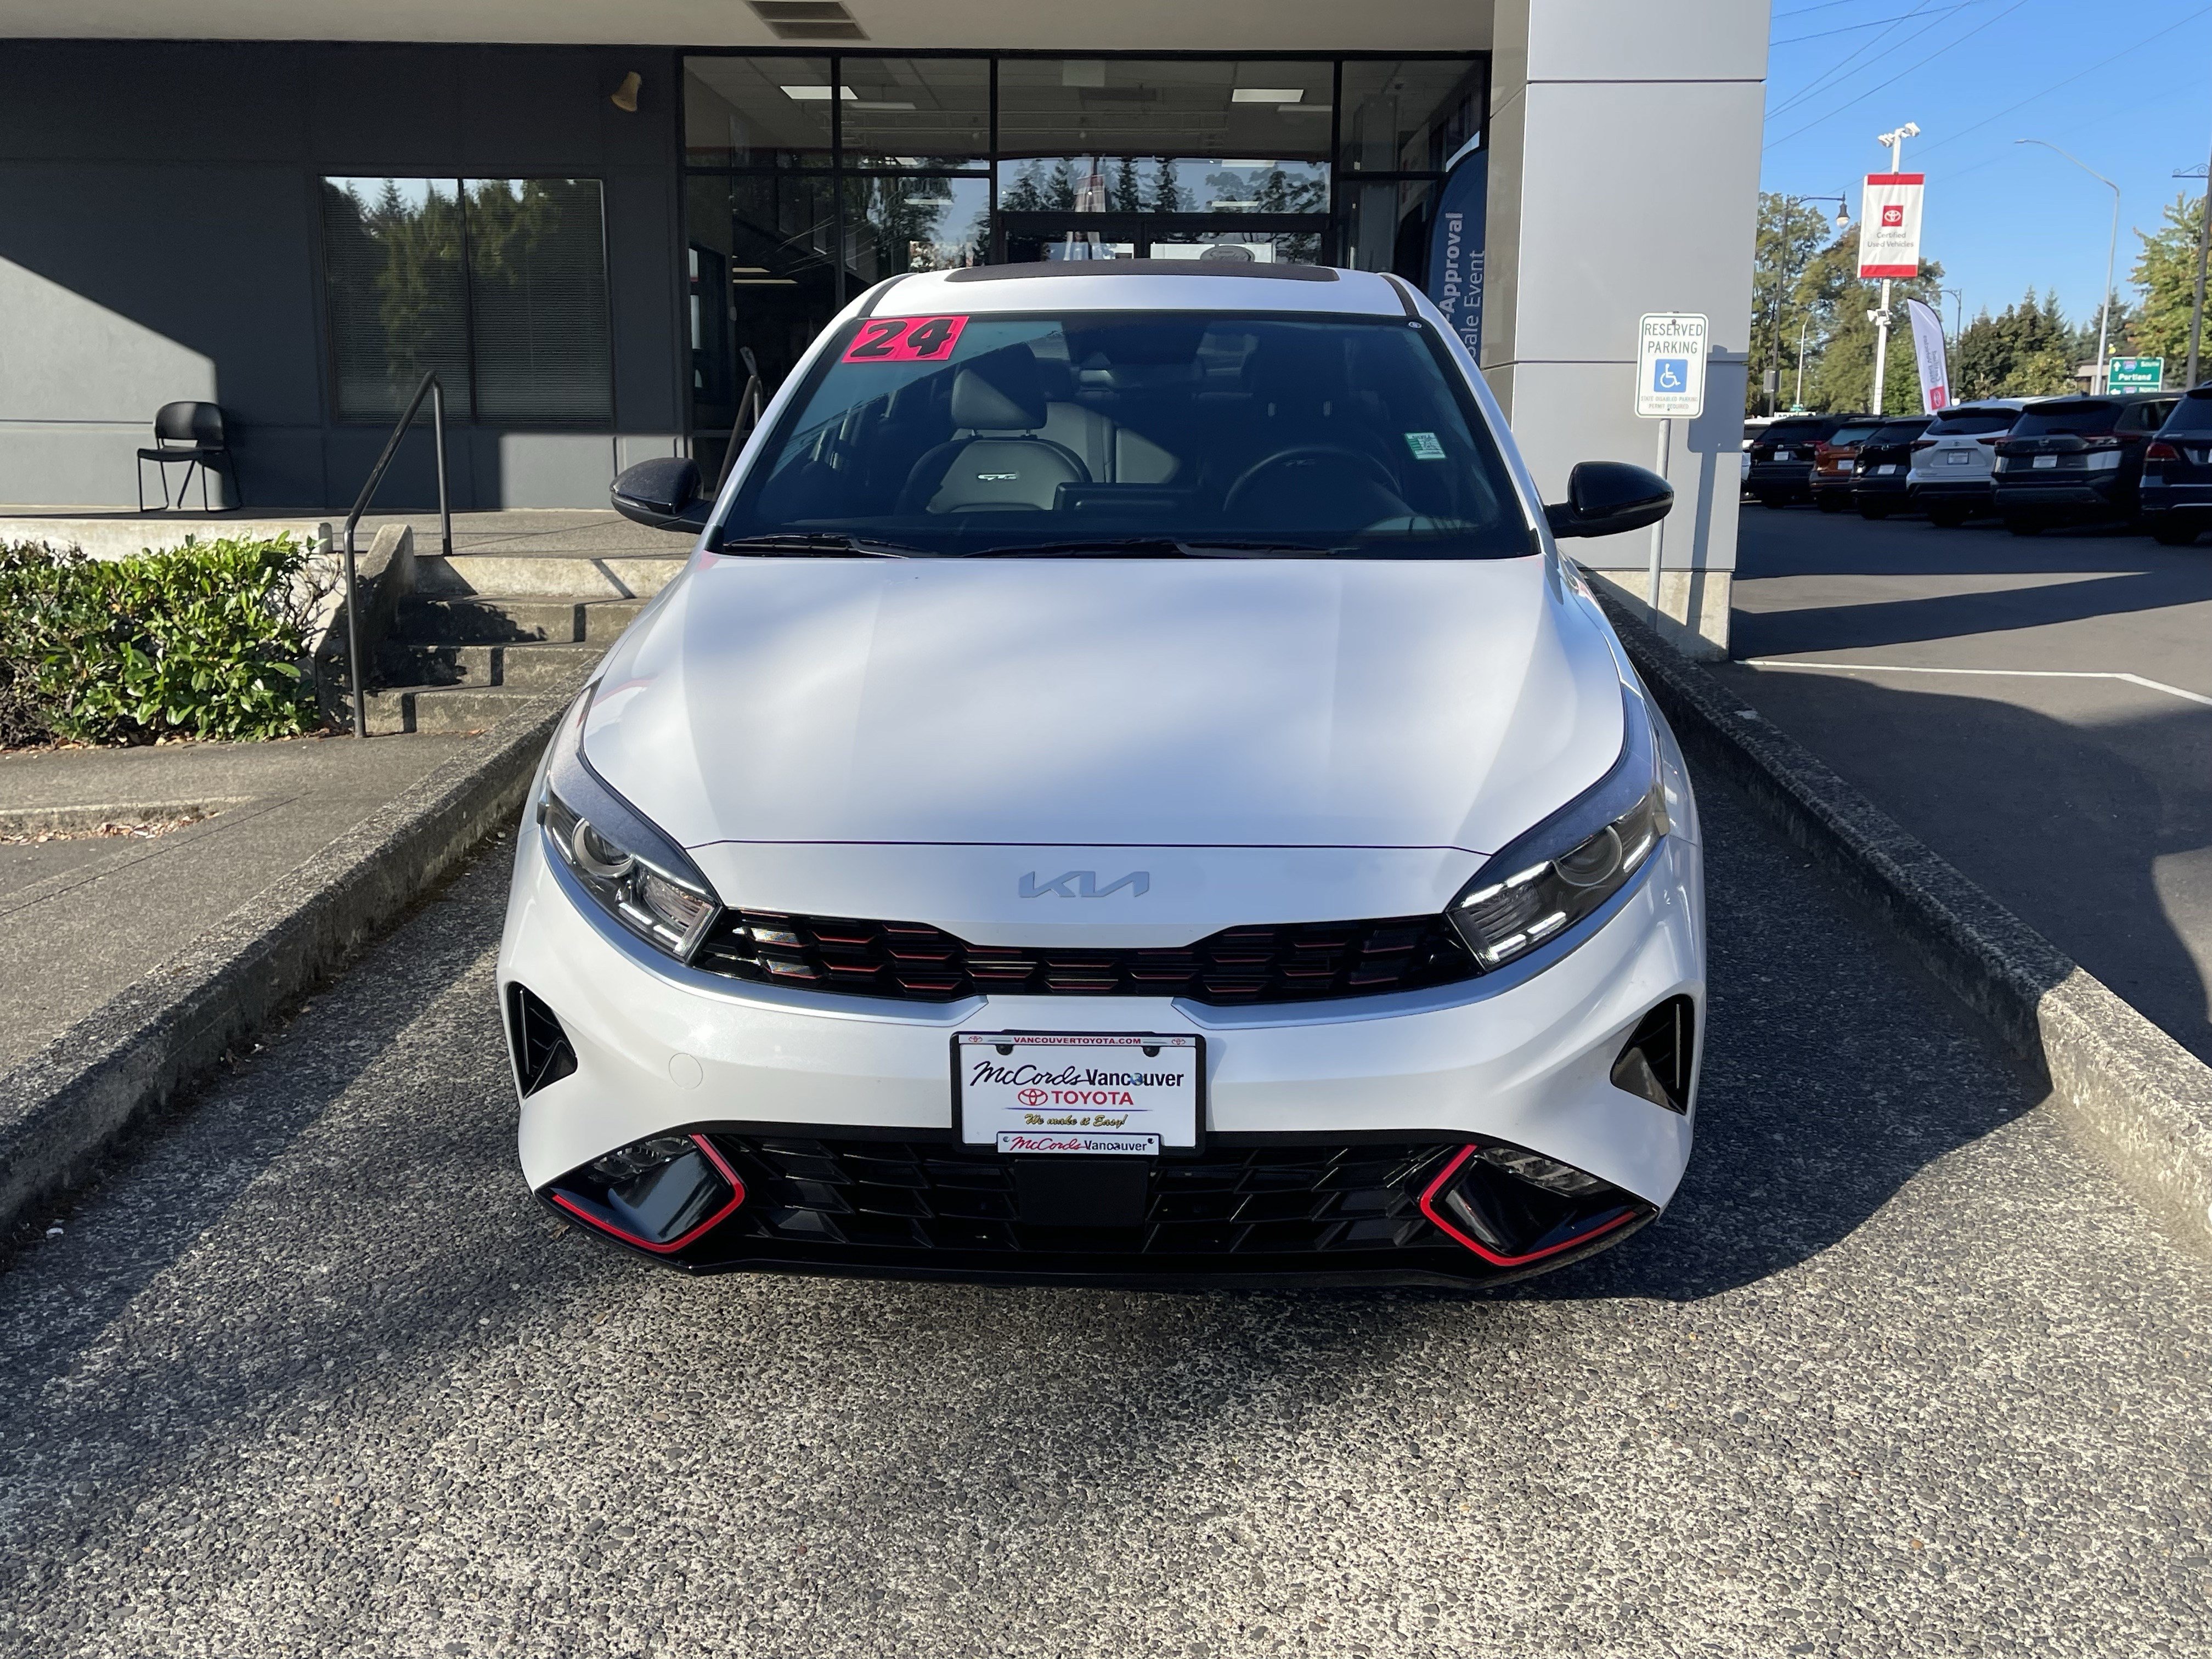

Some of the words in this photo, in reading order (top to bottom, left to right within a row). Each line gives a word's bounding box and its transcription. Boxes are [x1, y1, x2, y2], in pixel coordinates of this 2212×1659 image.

[1439, 212, 1463, 325] -Approval
[1464, 249, 1485, 308] Event
[1645, 323, 1703, 336] RESERVED
[850, 319, 952, 357] 24
[1647, 341, 1698, 353] PARKING
[1013, 1036, 1141, 1045] VANCOUVERTOYOTA.COM
[1051, 1090, 1135, 1105] TOYOTA
[1024, 1113, 1044, 1125] We
[1047, 1114, 1077, 1126] make
[1080, 1117, 1091, 1126] it
[1093, 1114, 1128, 1129] Easy!
